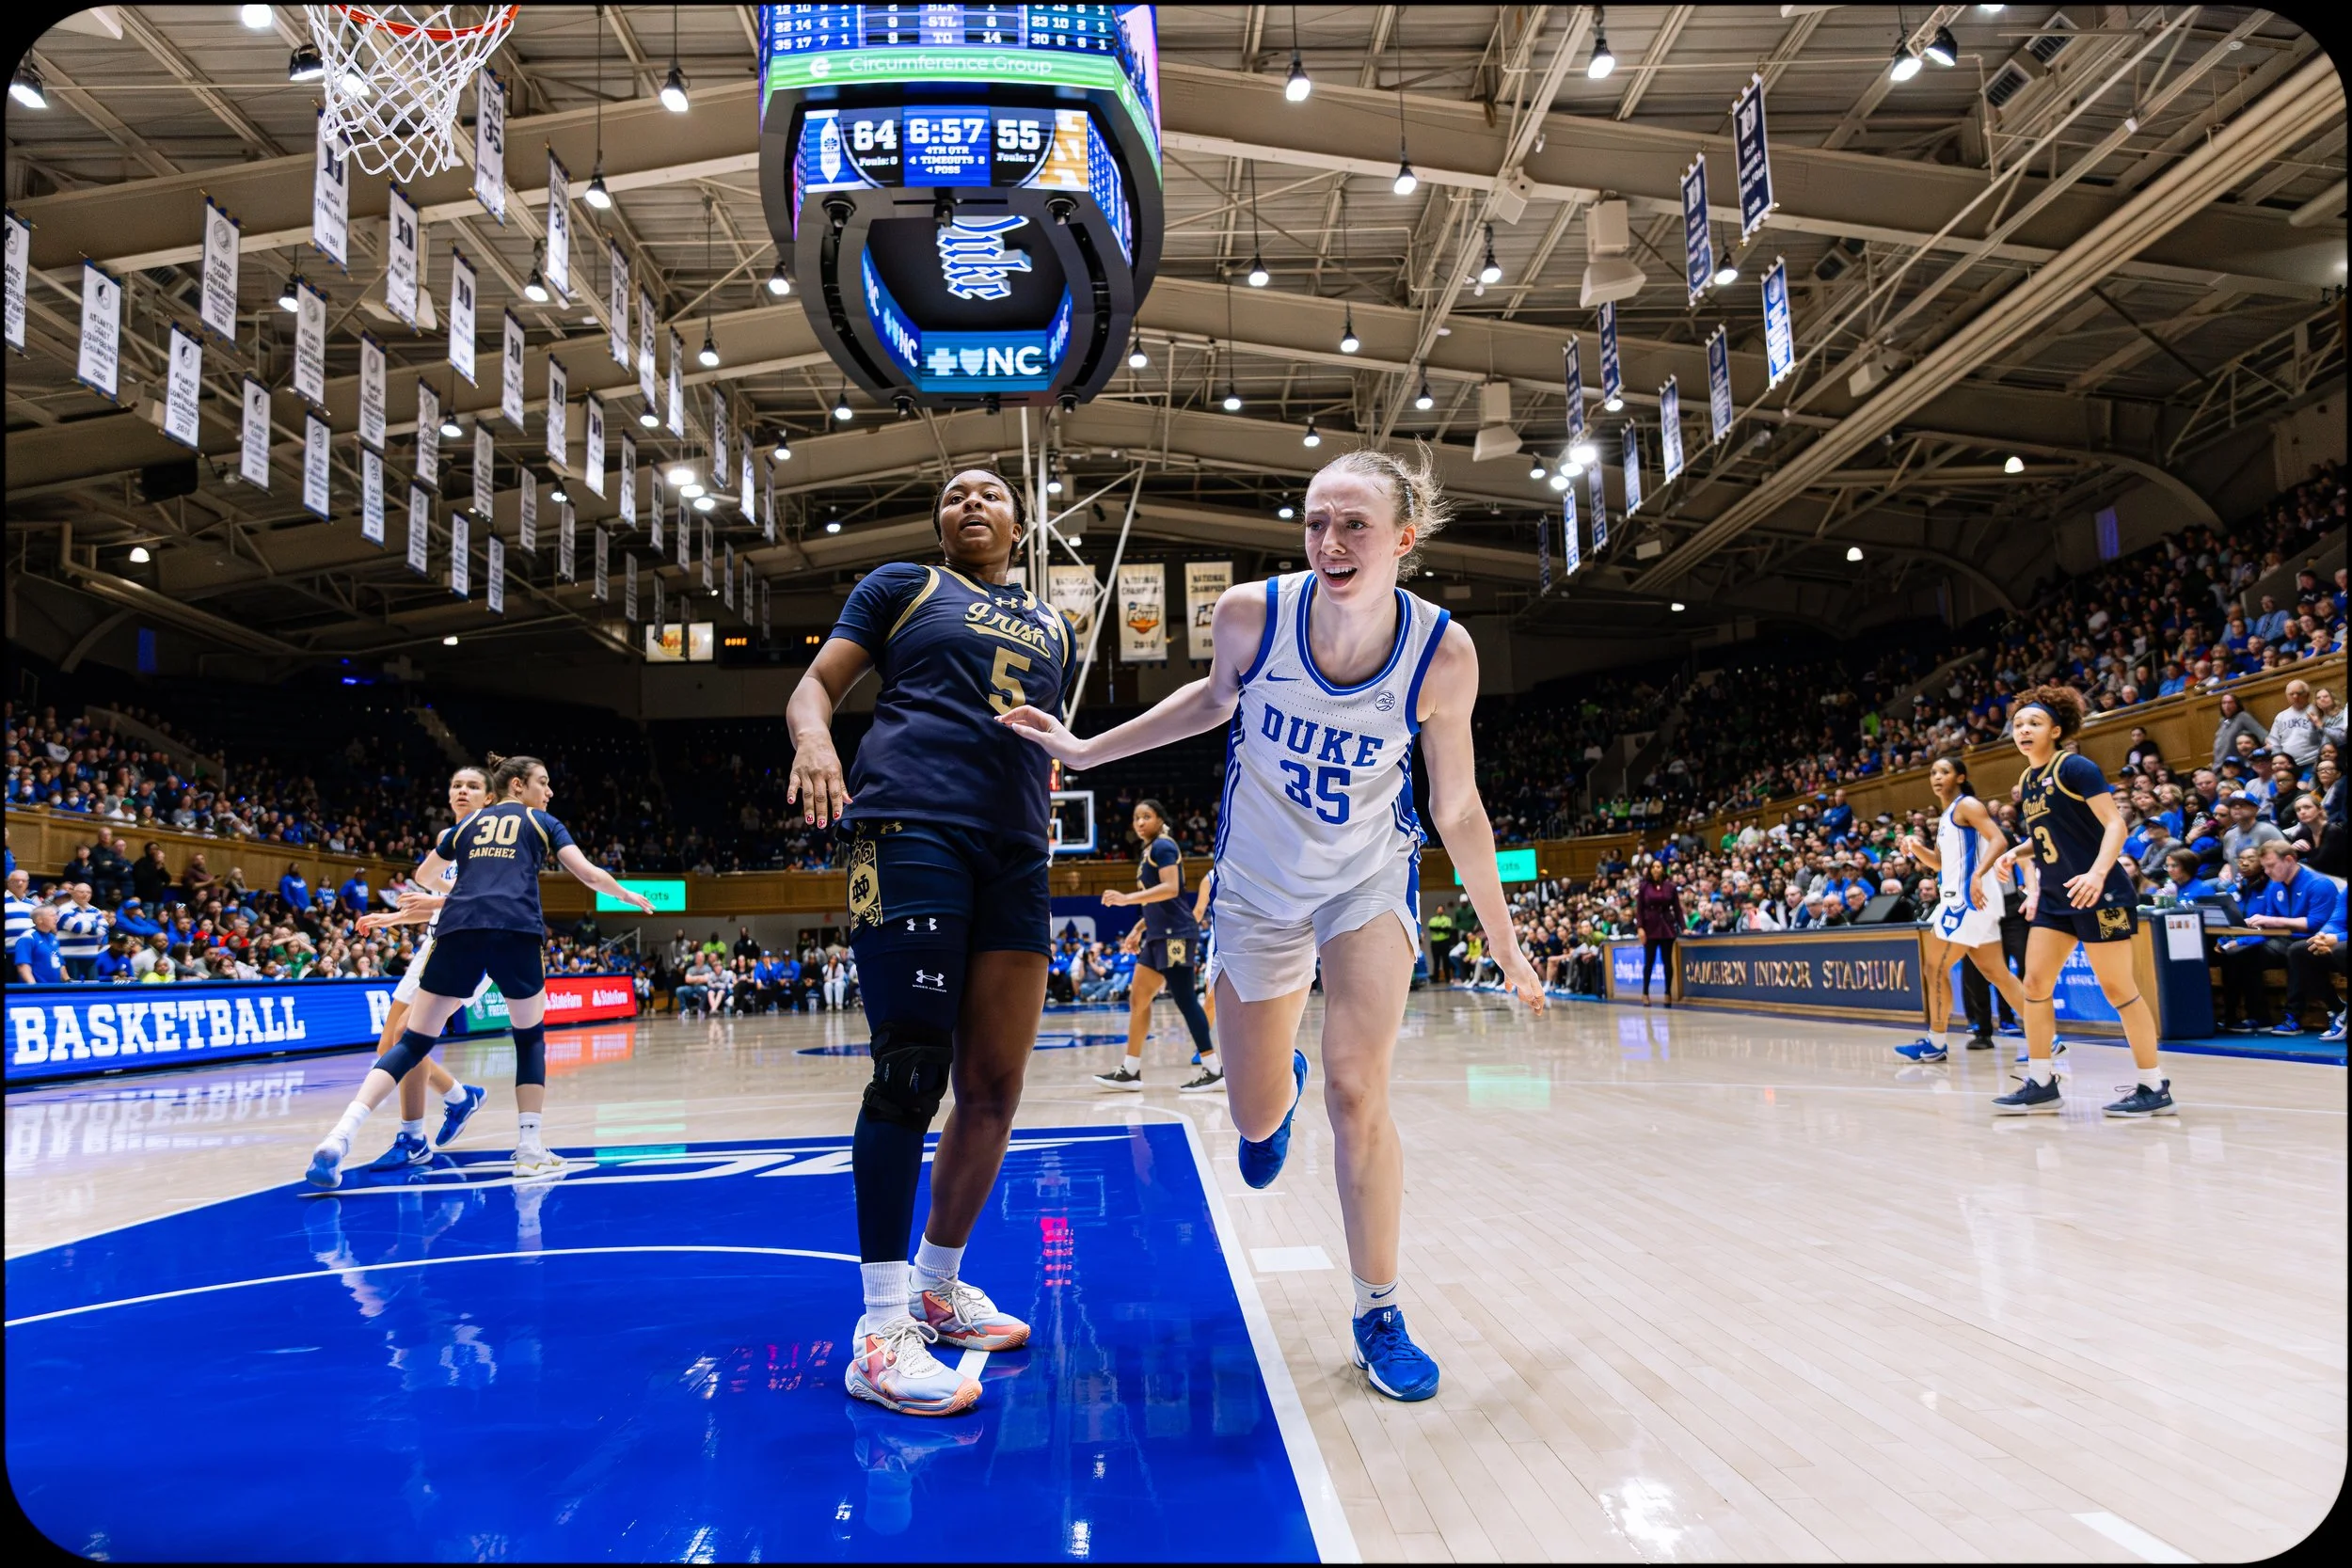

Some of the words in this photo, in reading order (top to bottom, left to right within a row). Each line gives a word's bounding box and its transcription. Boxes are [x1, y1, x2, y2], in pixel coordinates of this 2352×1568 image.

[775, 21, 791, 33] 22
[796, 19, 811, 31] 14
[819, 17, 829, 28] 4
[840, 16, 849, 27] 1
[929, 16, 957, 27] STL
[1031, 16, 1048, 27] 23
[1053, 17, 1069, 29] 10
[1076, 19, 1086, 30] 2
[1098, 22, 1105, 32] 1
[775, 39, 792, 51] 35
[796, 37, 812, 49] 17
[819, 35, 829, 46] 7
[841, 34, 850, 45] 1
[933, 32, 952, 43] TO
[983, 32, 1001, 43] 14
[1031, 33, 1049, 45] 30
[1099, 39, 1106, 50] 1
[850, 55, 989, 71] Circumference
[993, 56, 1052, 75] Group
[853, 119, 897, 150] 64
[909, 119, 985, 144] 6:57
[997, 119, 1040, 150] 55
[909, 156, 916, 165] 4
[920, 155, 975, 165] TIMEOUTS
[925, 146, 946, 154] 4TH
[947, 146, 969, 155] QTR
[934, 166, 961, 174] POSS
[987, 346, 1043, 375] NC
[965, 601, 1051, 658] Irish
[989, 645, 1031, 716] 5
[1261, 703, 1385, 767] DUKE
[1280, 759, 1351, 825] 35
[472, 815, 521, 845] 30
[469, 847, 516, 859] SANCHEZ
[2033, 826, 2058, 864] 3
[1685, 960, 1748, 986] CAMERON
[1754, 960, 1813, 988] INDOOR
[1821, 959, 1910, 991] STADIUM
[9, 996, 306, 1065] BASKETBALL
